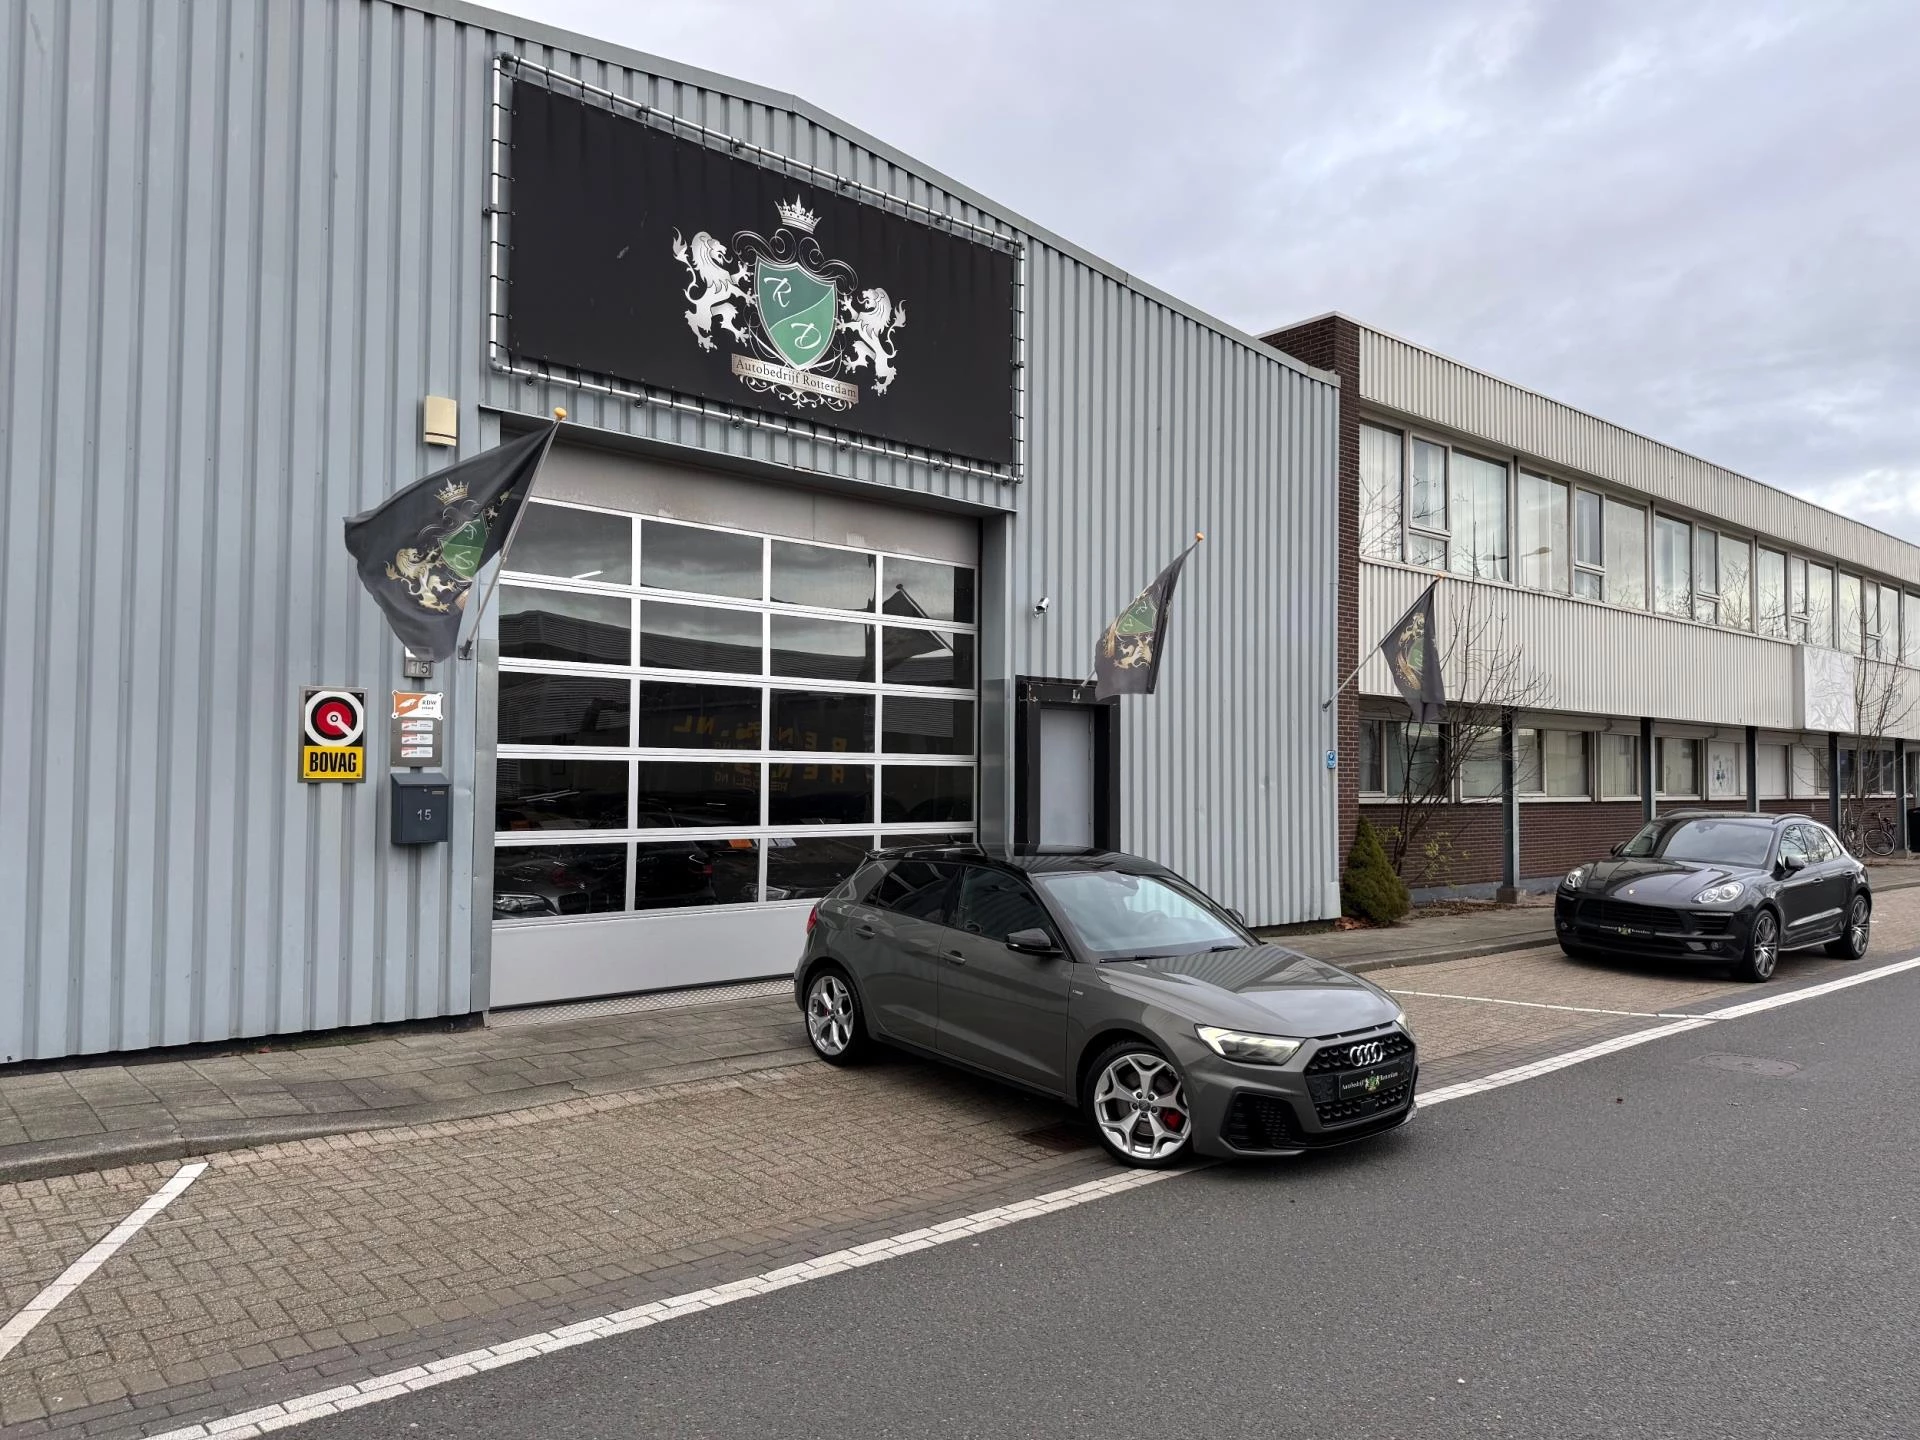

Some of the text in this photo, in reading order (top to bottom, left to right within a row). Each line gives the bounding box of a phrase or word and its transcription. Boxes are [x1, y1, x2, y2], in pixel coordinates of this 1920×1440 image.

[735, 358, 857, 398] Autobedrijf Rotterdam
[309, 751, 357, 773] BOVAG
[416, 809, 432, 821] 15
